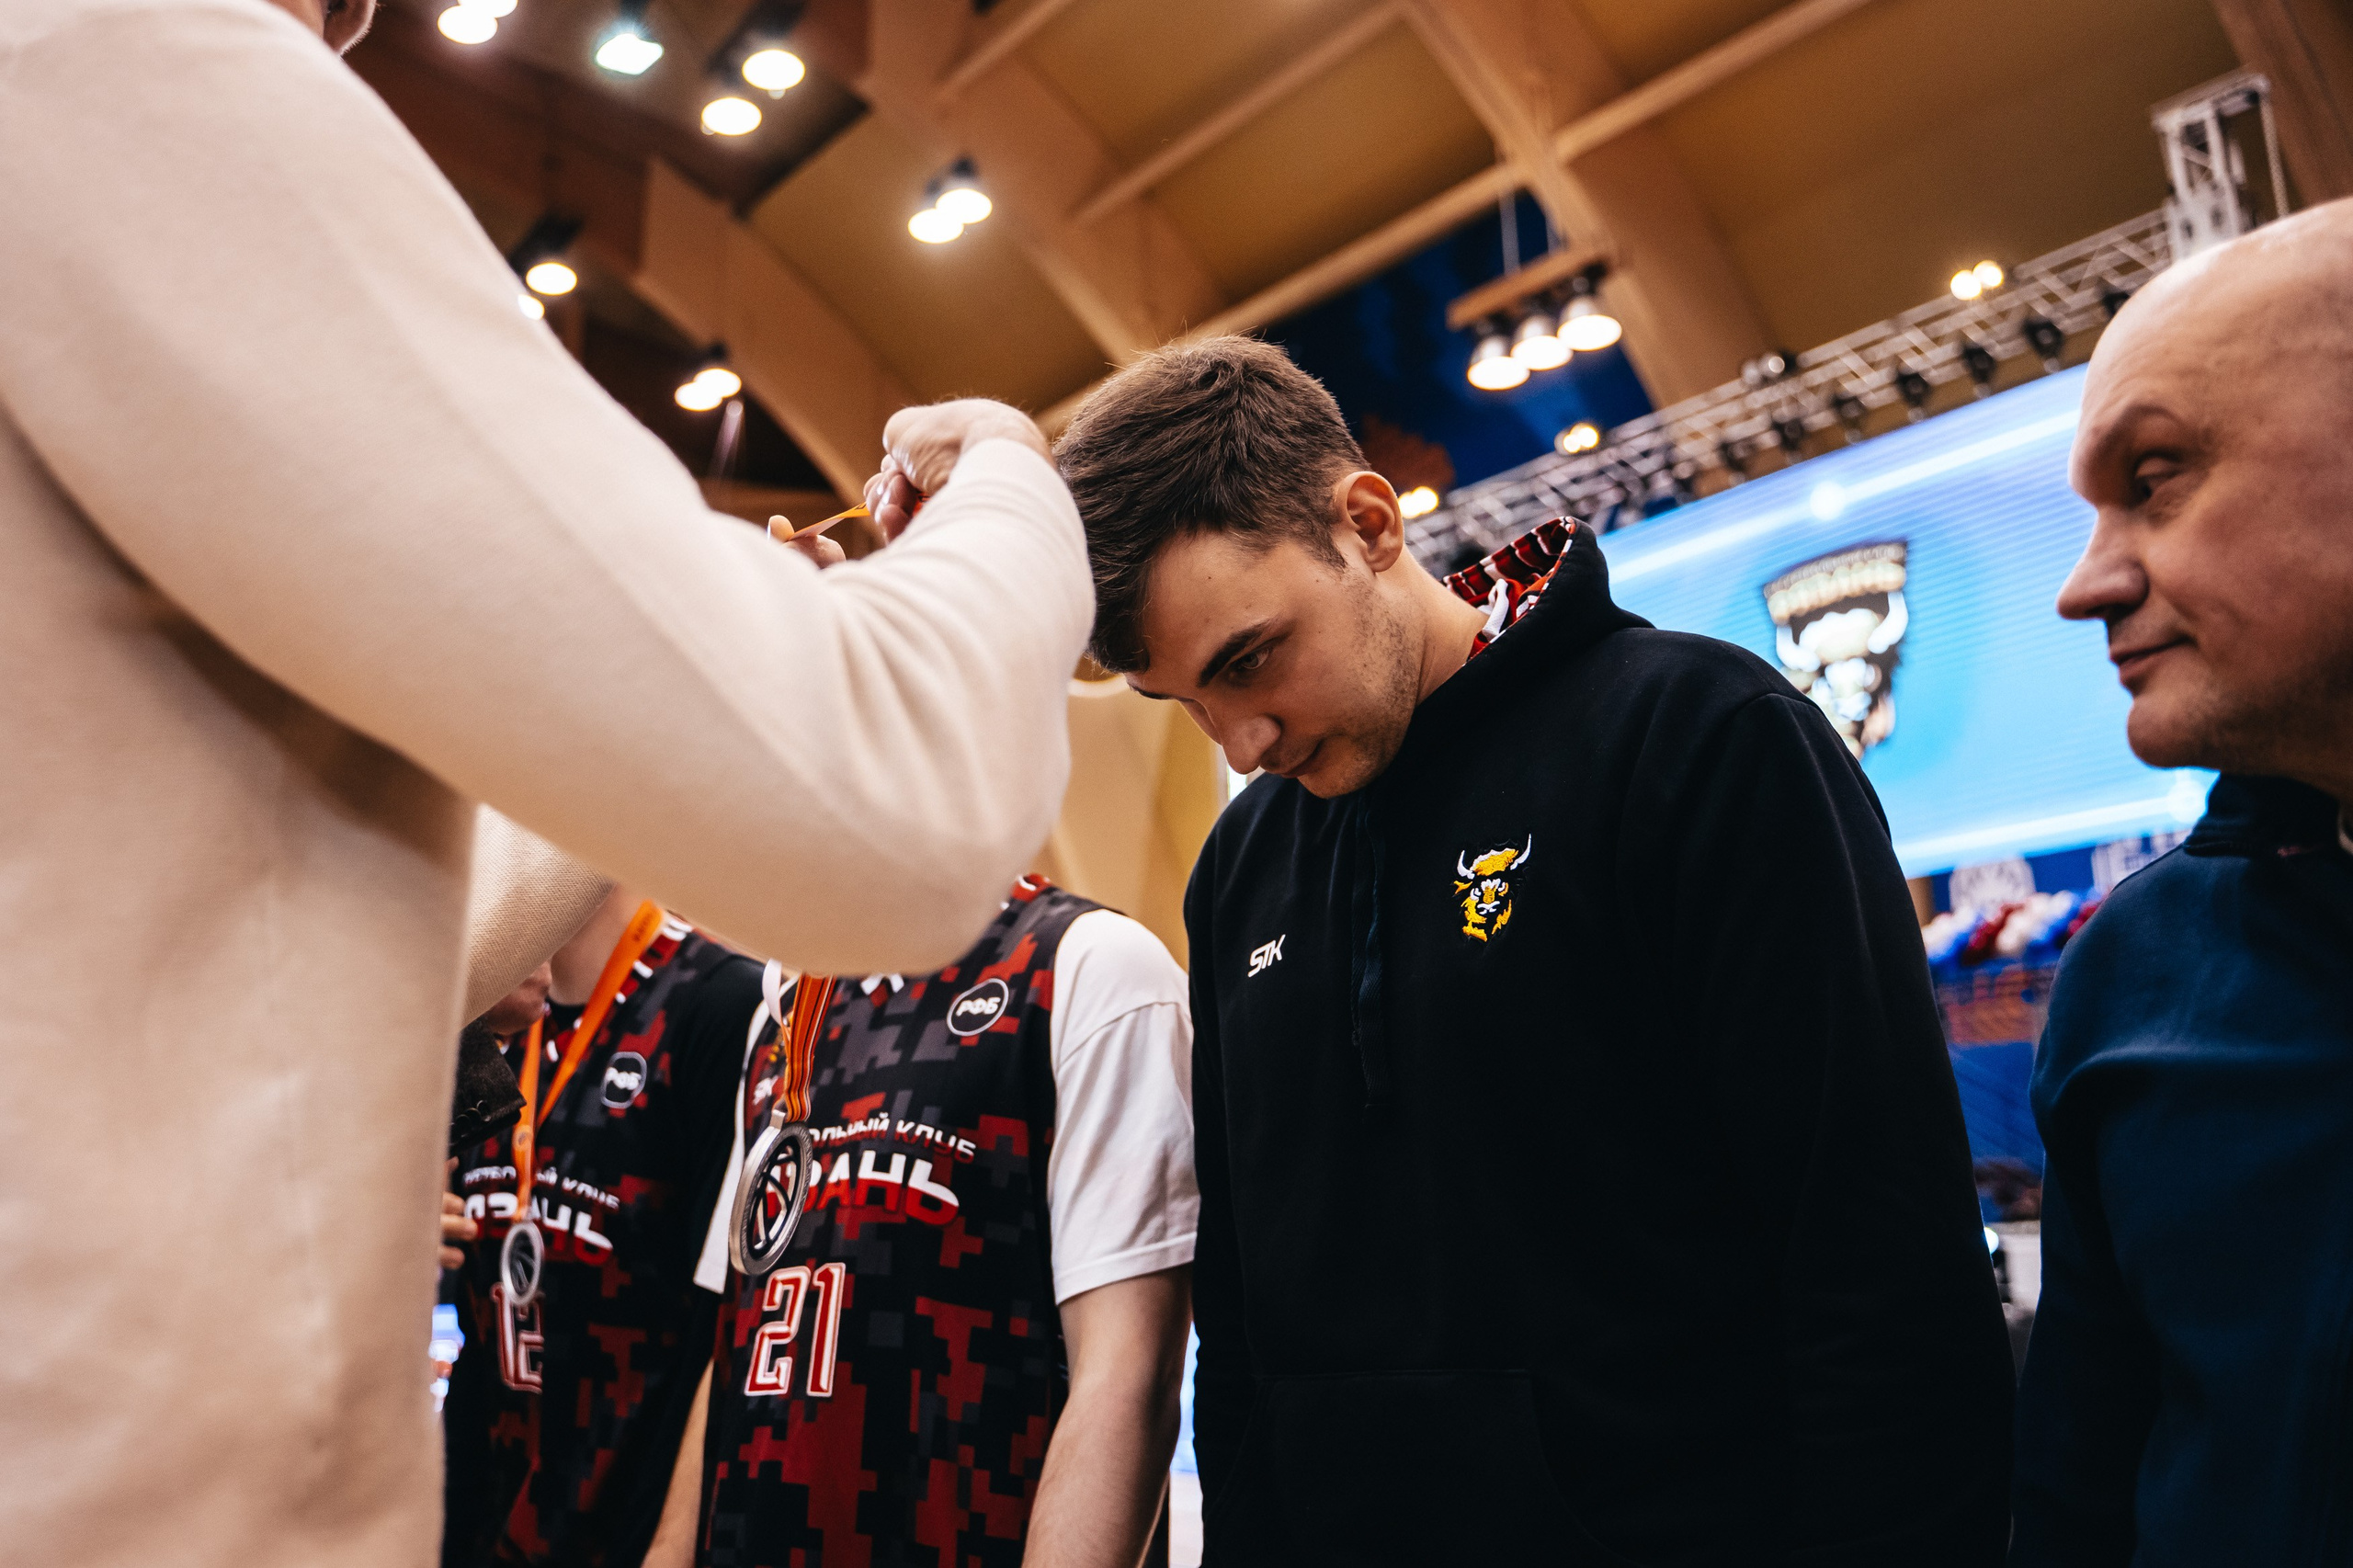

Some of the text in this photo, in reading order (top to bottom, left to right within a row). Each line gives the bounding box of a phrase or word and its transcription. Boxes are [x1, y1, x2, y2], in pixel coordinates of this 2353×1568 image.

[1247, 934, 1287, 978] STK
[809, 1111, 976, 1165] ОЛЬНЫЙ КЛУБ
[744, 1262, 847, 1397] 21
